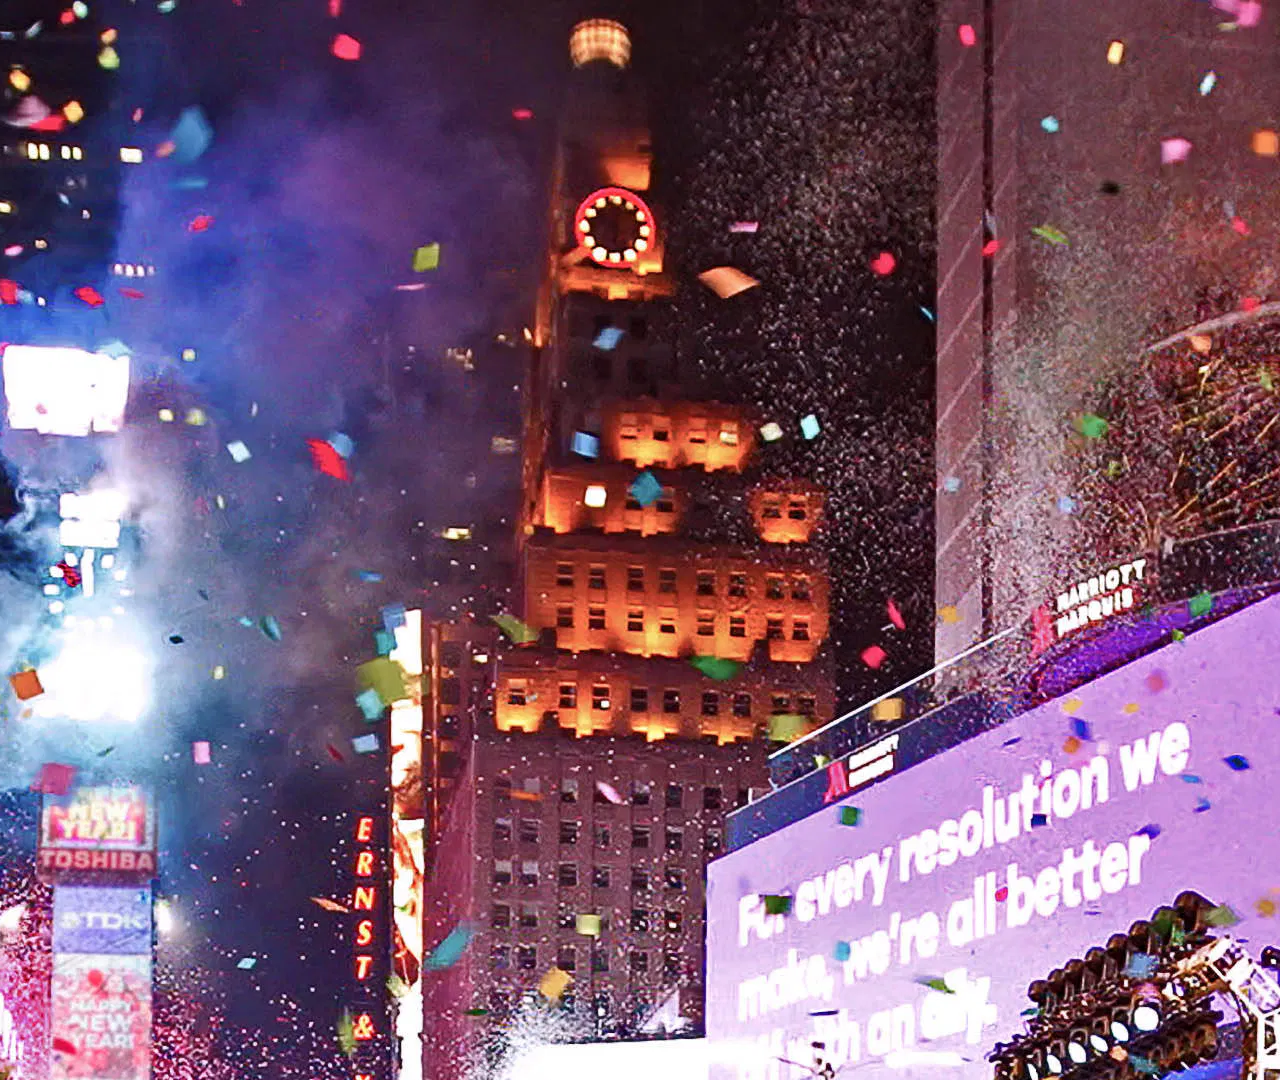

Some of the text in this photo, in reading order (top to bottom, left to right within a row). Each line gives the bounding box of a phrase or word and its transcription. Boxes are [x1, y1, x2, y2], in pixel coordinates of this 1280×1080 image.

[795, 845, 893, 922] every
[899, 755, 1110, 883] resolution
[1120, 721, 1191, 791] we
[40, 848, 154, 871] TOSHIBA
[354, 816, 374, 979] ERNST
[946, 871, 996, 946] all
[1006, 834, 1153, 929] better
[86, 910, 147, 930] TDK
[70, 1013, 132, 1033] NEW
[353, 1013, 374, 1040] &
